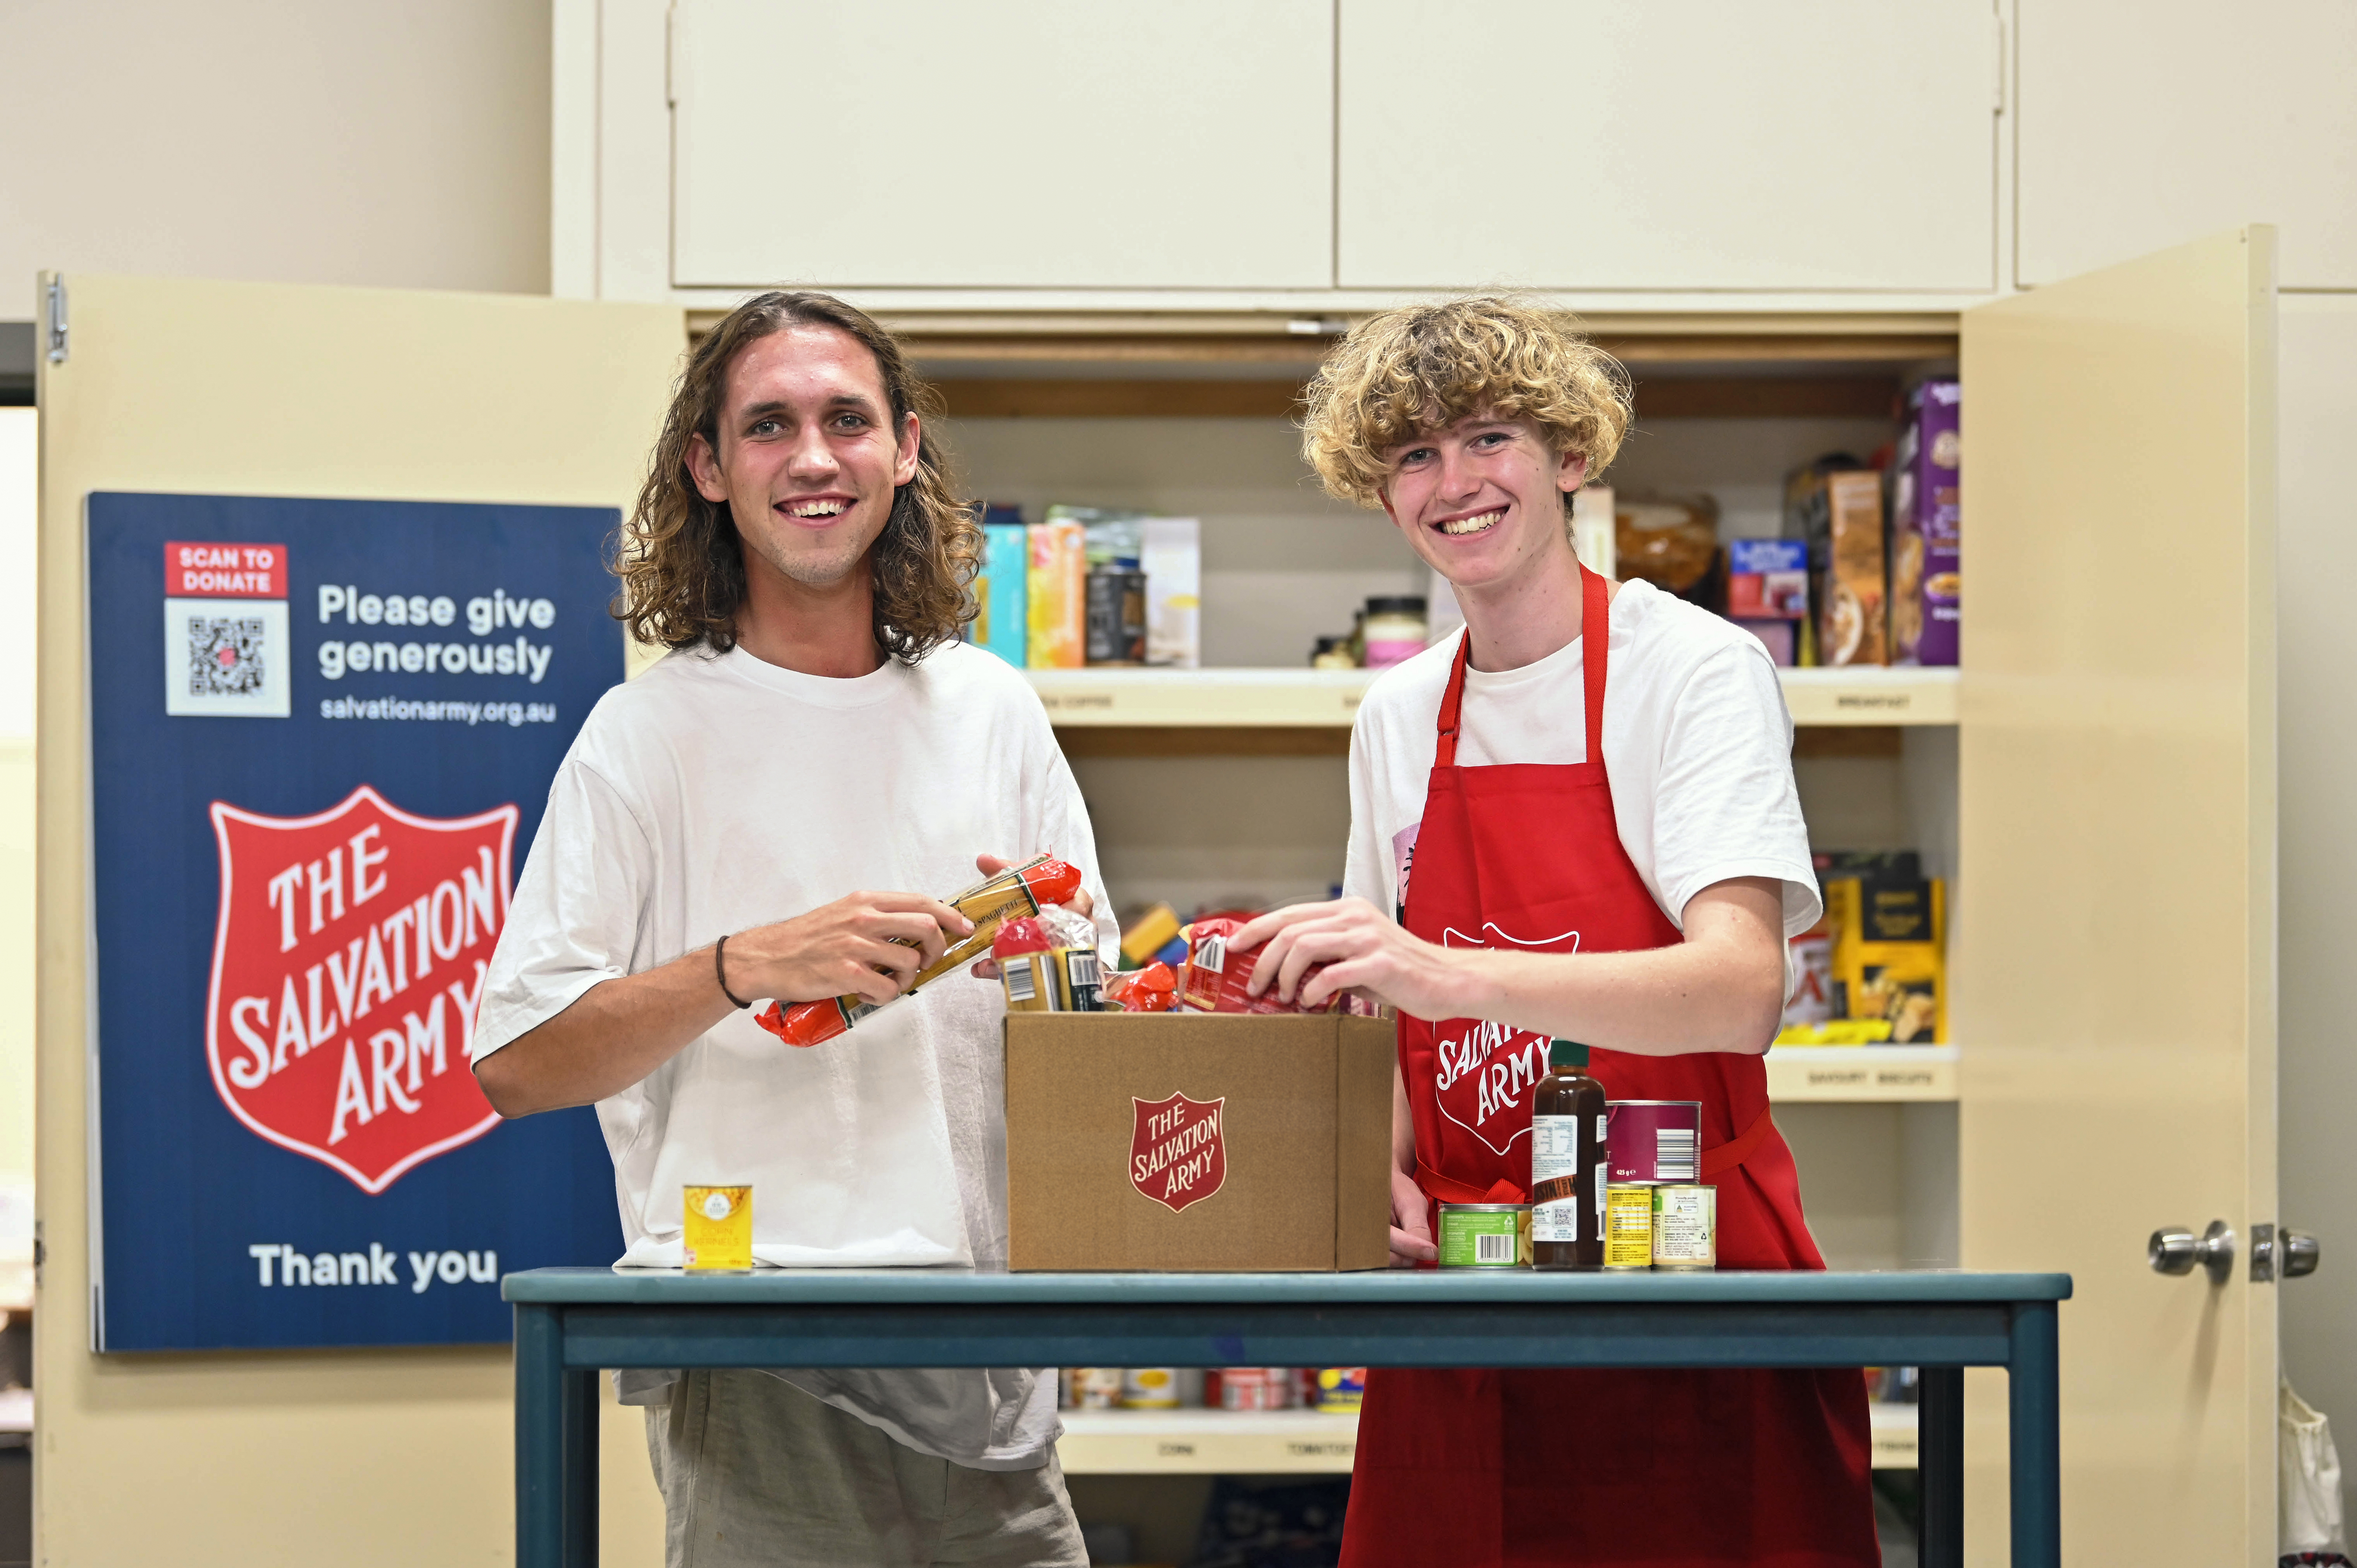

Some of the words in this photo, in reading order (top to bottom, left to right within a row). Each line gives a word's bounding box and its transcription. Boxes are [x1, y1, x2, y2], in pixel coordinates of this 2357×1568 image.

[179, 547, 239, 569] SCAN
[243, 548, 274, 570] TO
[183, 570, 271, 593] DONATE
[318, 584, 456, 626] Please
[466, 589, 555, 636] give
[318, 637, 552, 683] generously
[320, 696, 557, 727] salvationarmy.org.au
[268, 824, 389, 952] THE
[977, 899, 1019, 926] SPAGHETTI
[228, 846, 495, 1089] SALVATION
[328, 959, 488, 1145] ARMY
[1436, 1019, 1525, 1091] SALVA
[1477, 1035, 1556, 1127] ARMY
[1134, 1109, 1218, 1182] SALVATION
[1148, 1102, 1185, 1141] THE
[1163, 1144, 1215, 1200] ARMY
[249, 1243, 397, 1286] Thank
[409, 1251, 496, 1293] you
